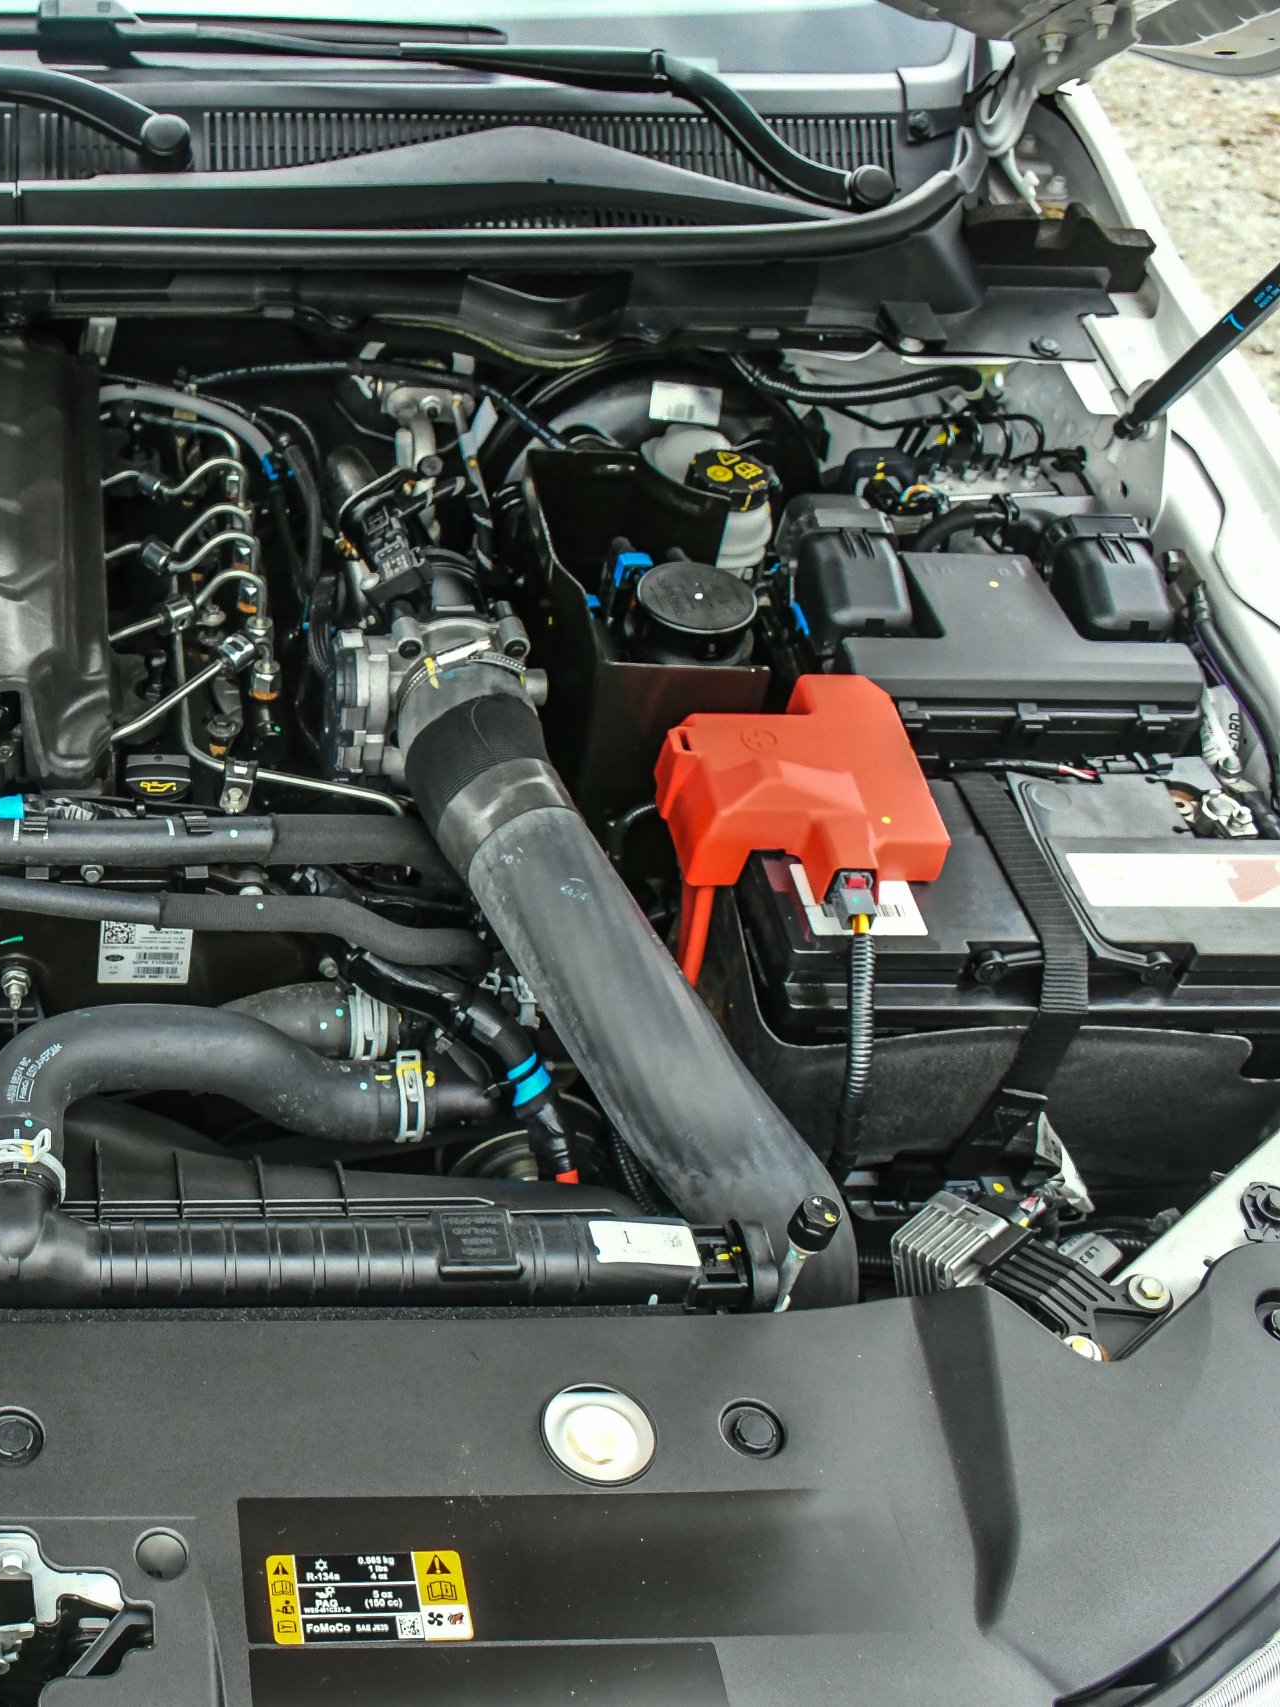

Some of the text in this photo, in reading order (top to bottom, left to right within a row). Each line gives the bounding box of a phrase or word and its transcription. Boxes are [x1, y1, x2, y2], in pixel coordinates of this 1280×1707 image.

[382, 1555, 395, 1566] kg
[306, 1572, 341, 1582] R-134a
[370, 1572, 377, 1580] 4
[380, 1591, 394, 1599] oz
[315, 1599, 339, 1608] PAG
[364, 1597, 403, 1610] (150 cc)
[306, 1623, 351, 1634] FoMoCo
